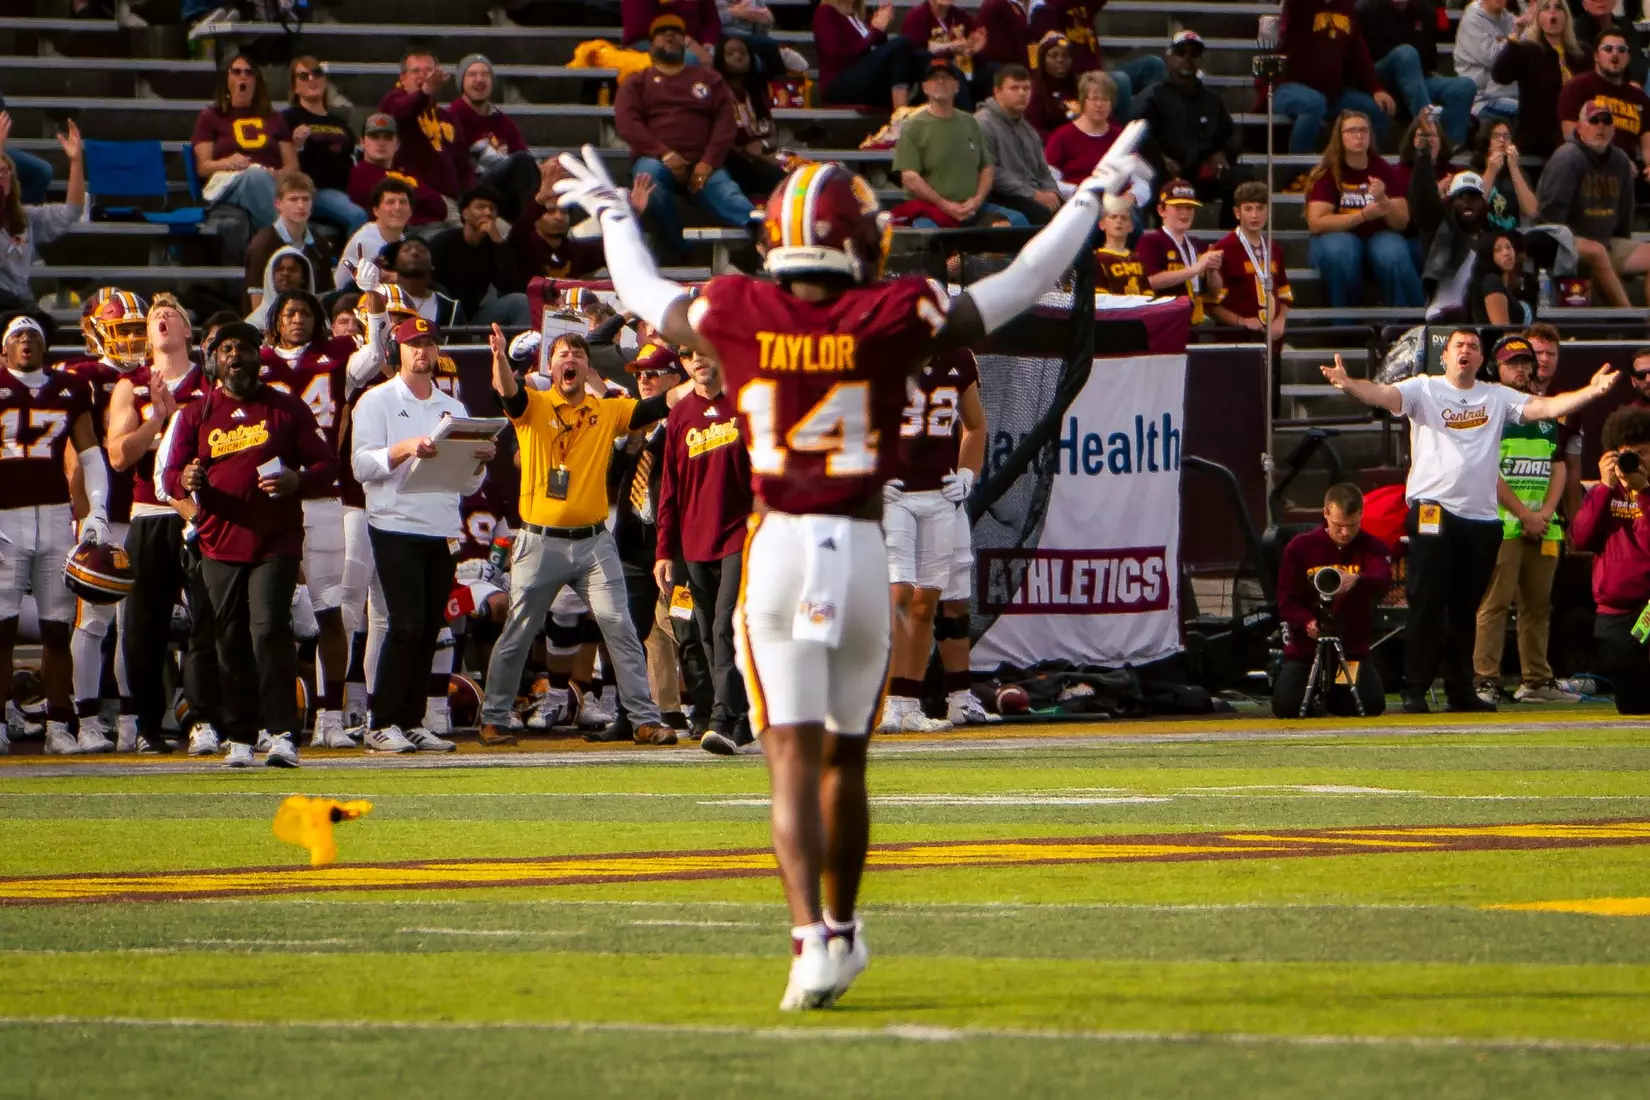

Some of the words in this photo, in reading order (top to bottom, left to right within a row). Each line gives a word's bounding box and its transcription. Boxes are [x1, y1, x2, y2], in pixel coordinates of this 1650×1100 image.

[231, 116, 267, 149] C
[415, 319, 429, 333] C
[755, 330, 856, 372] TAYLOR
[265, 372, 336, 429] 4
[1441, 406, 1487, 423] Central
[0, 408, 68, 460] 17
[208, 420, 266, 447] Central
[686, 417, 736, 447] Central
[737, 377, 881, 476] 14
[1512, 459, 1552, 476] MAC
[987, 556, 1163, 605] ATHLETICS
